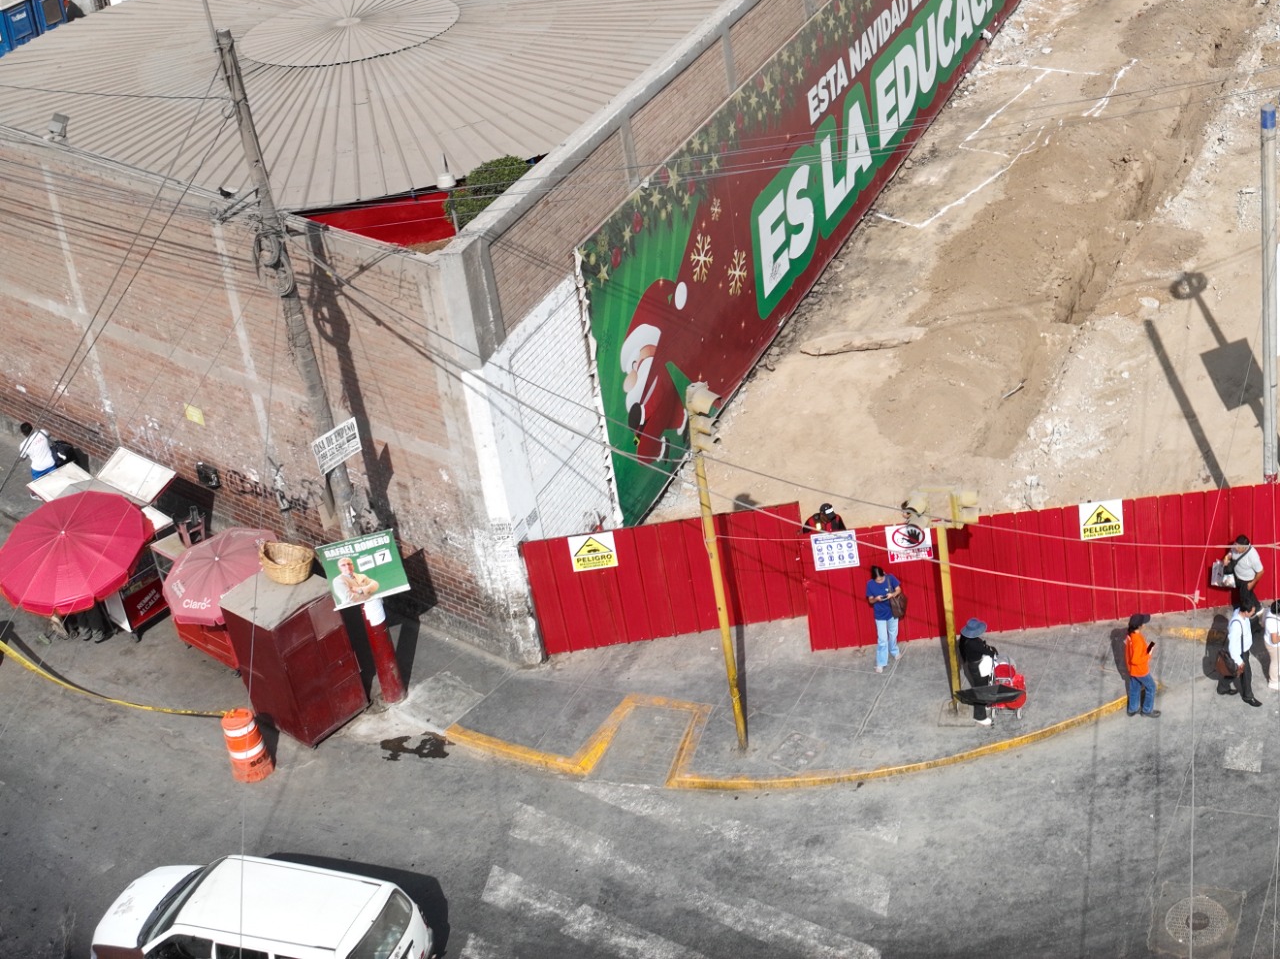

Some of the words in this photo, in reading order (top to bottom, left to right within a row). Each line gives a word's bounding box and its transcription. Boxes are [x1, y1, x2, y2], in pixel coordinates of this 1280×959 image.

[807, 58, 849, 125] ESTA
[758, 164, 815, 299] ES
[820, 98, 872, 220] LA
[1083, 524, 1120, 534] PELIGRO
[324, 545, 354, 558] RAFAEL
[354, 536, 390, 552] ROMERO
[379, 553, 386, 561] 7
[576, 554, 612, 563] PELIGRO
[140, 592, 160, 616] ALCALDE
[182, 599, 207, 610] Claro
